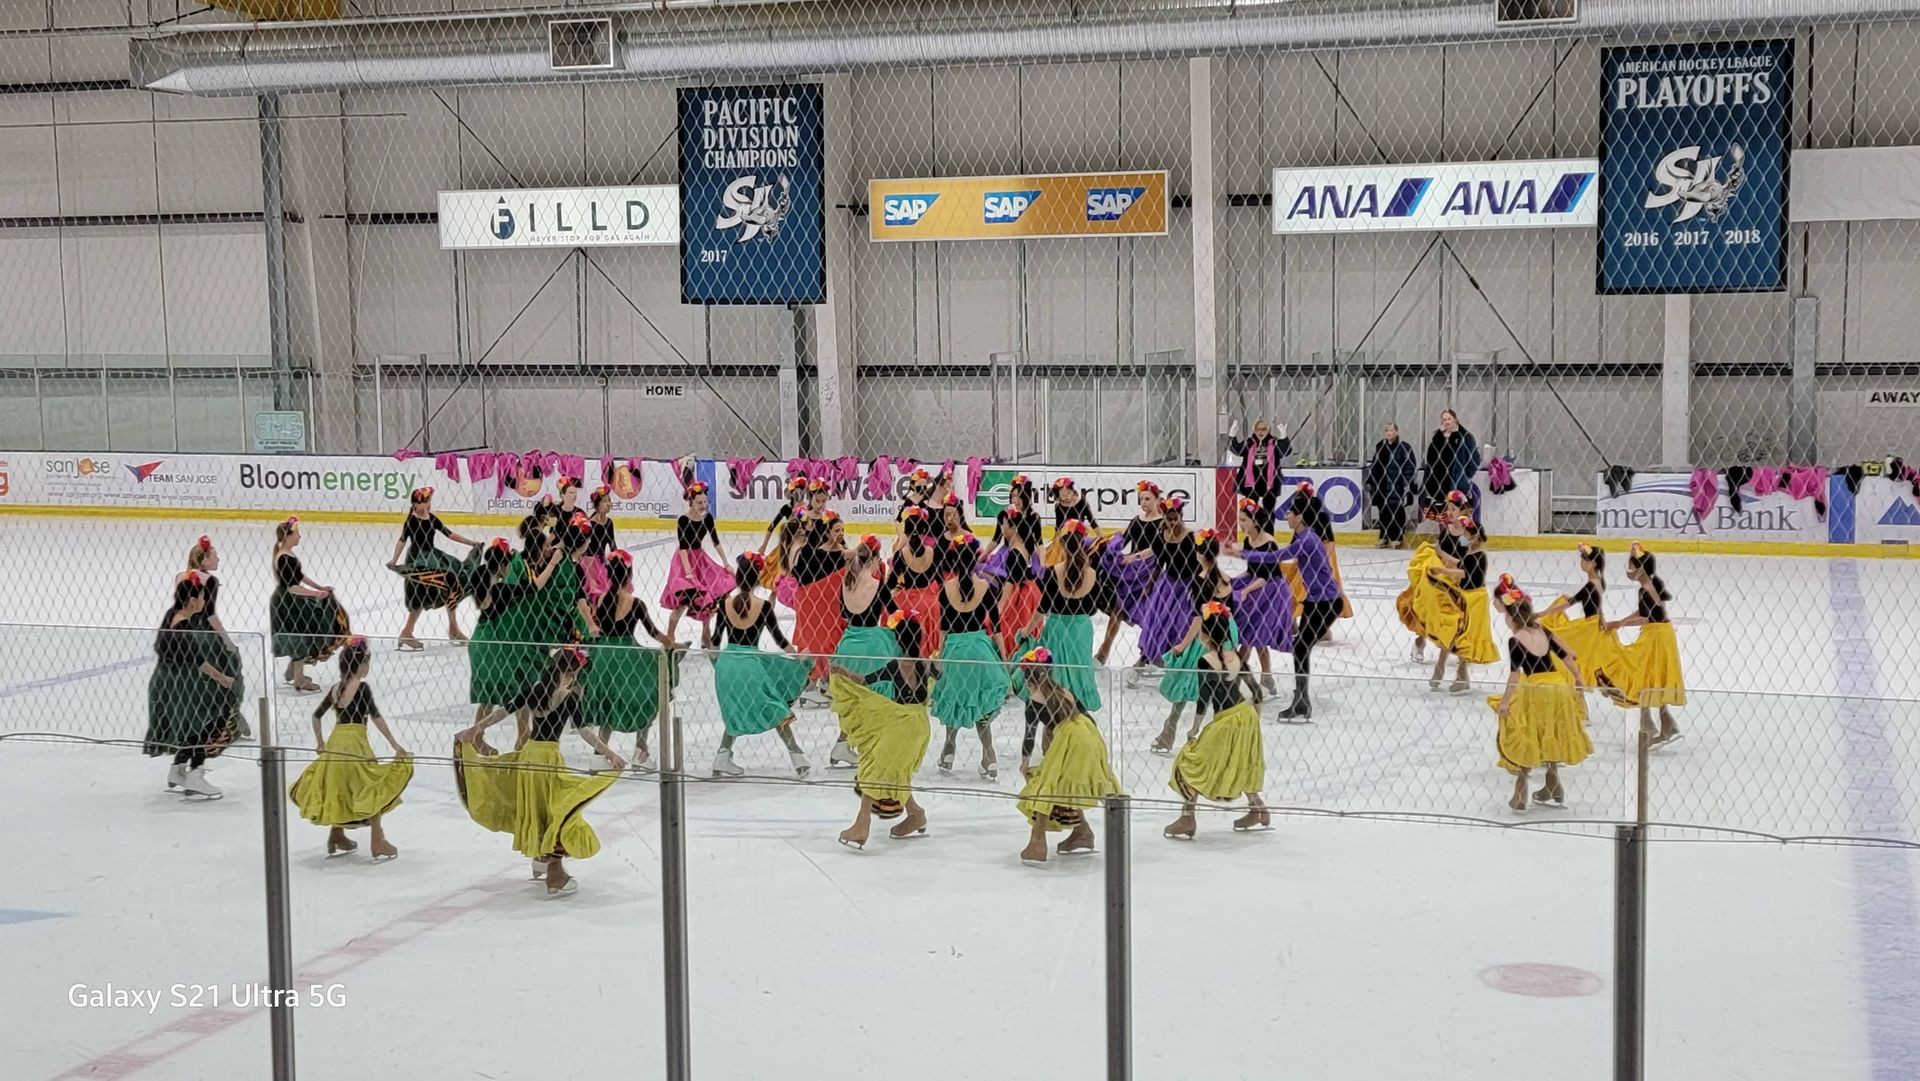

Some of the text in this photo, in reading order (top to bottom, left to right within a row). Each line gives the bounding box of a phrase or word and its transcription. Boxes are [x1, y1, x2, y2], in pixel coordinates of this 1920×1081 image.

[1618, 55, 1773, 73] AMERICAN HOCKEY LEAGUE
[1616, 72, 1772, 110] PLAYOFFS
[704, 97, 798, 126] PACIFIC
[703, 125, 799, 149] DIVISION
[704, 148, 798, 169] CHAMPIONS
[884, 194, 1132, 221] SAP SAP SAP
[1286, 179, 1539, 219] ANA ANA
[1624, 230, 1761, 247] 2016 2017 2018
[701, 250, 728, 263] 2017
[646, 385, 683, 396] HOME
[1870, 391, 1920, 404] AWAY
[149, 474, 217, 485] TEAM SAN JOSE
[625, 502, 670, 514] orange
[852, 504, 894, 515] alkaline
